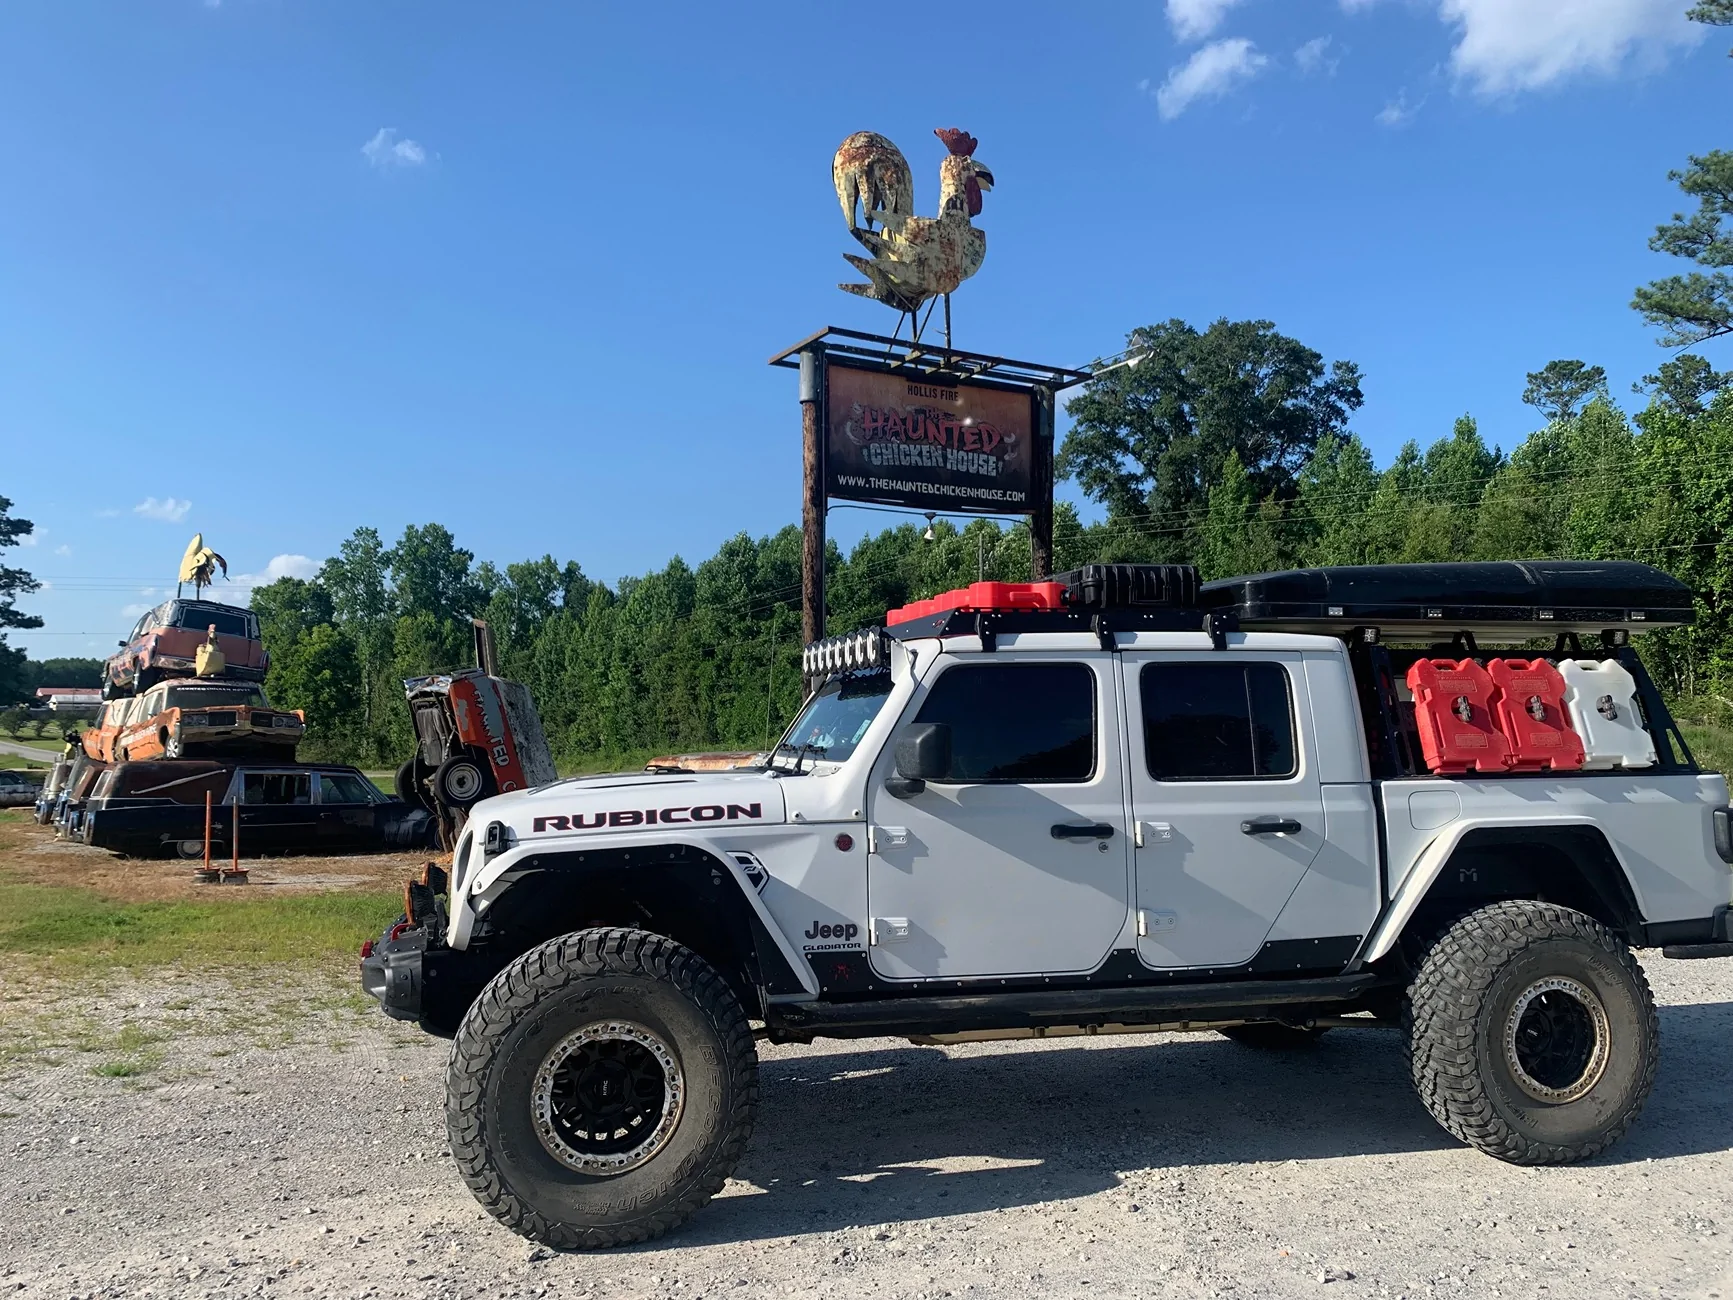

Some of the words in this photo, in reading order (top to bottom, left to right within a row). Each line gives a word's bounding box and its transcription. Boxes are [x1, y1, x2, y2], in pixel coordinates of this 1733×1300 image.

[907, 384, 938, 399] HOLLIS
[940, 389, 959, 402] FIRE
[862, 407, 1001, 454] HAUNTED
[869, 442, 944, 467] CHICKEN
[946, 448, 997, 477] HOUSE
[837, 474, 1026, 502] WWW.THEHAUNTEDCHICKENHOUSE.COM
[533, 802, 762, 833] RUBICON
[804, 920, 858, 942] Jeep
[802, 942, 862, 951] GLADIATOR
